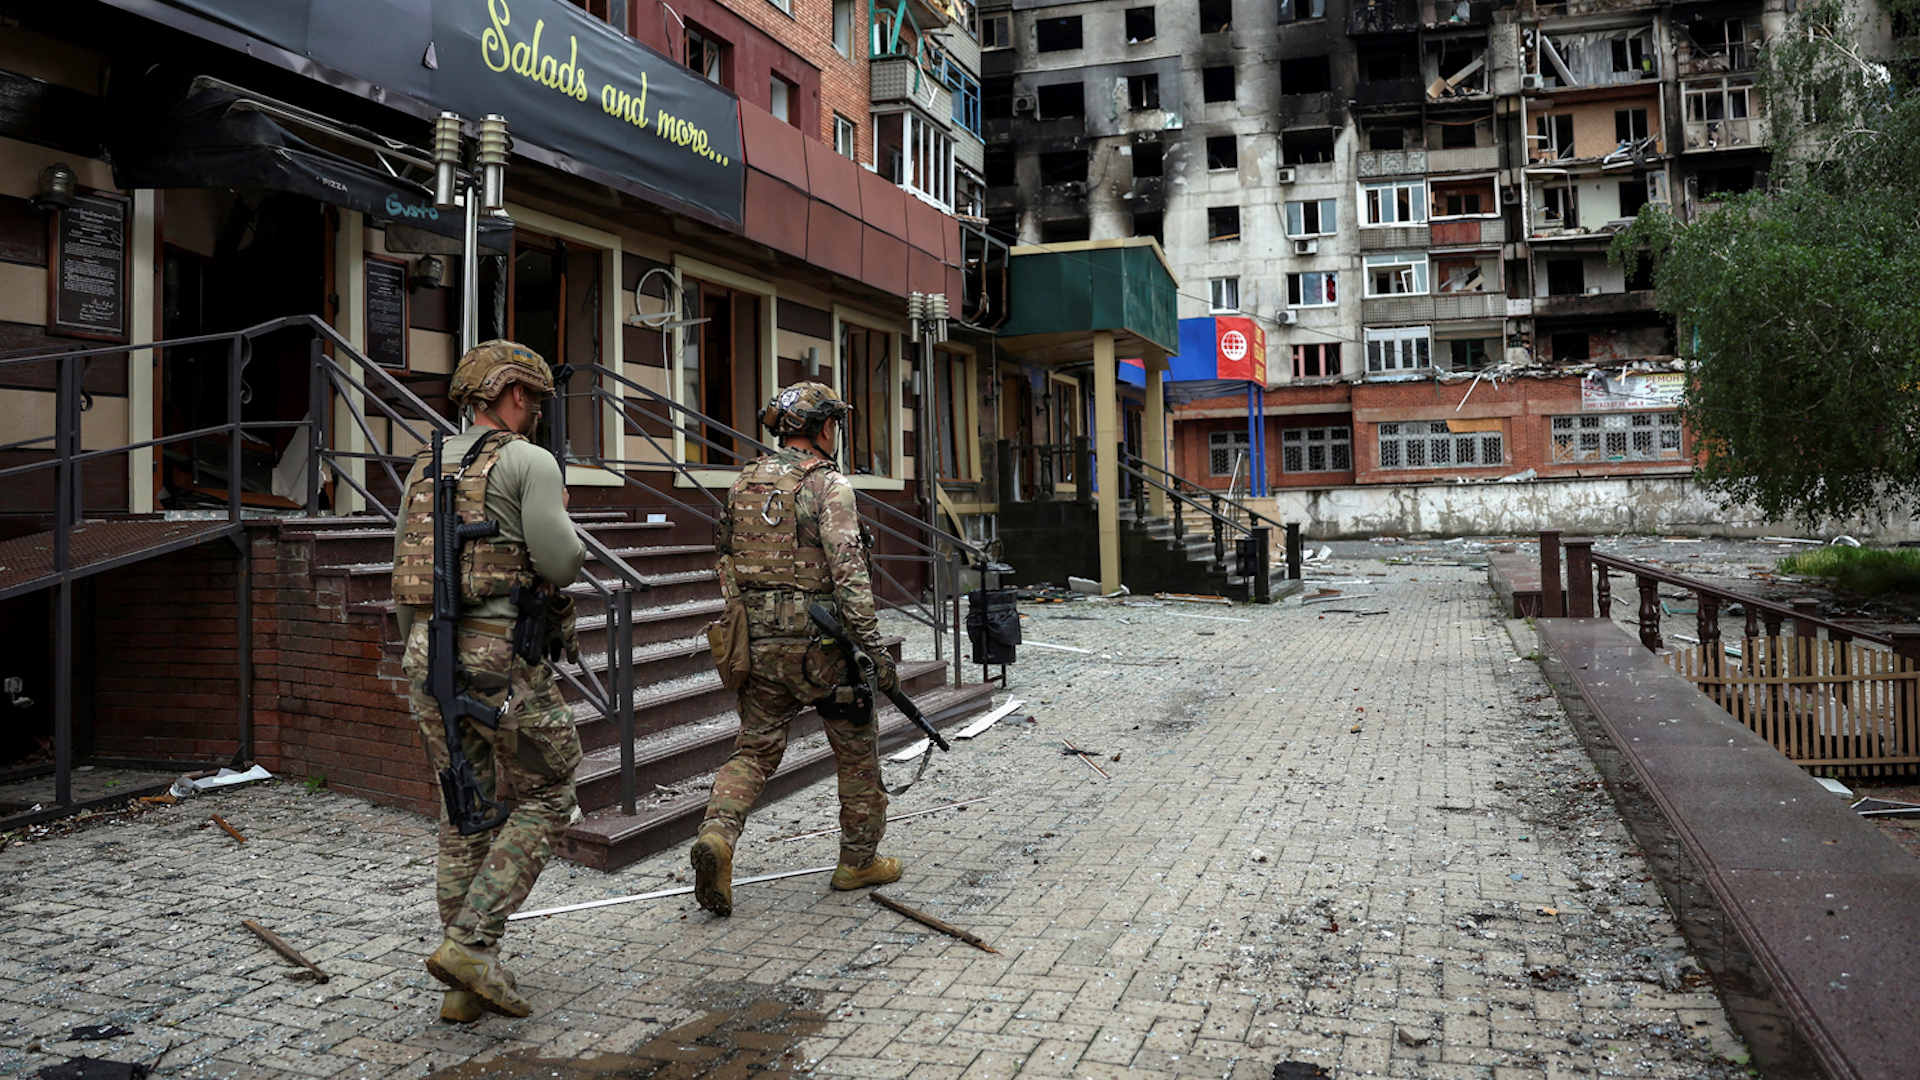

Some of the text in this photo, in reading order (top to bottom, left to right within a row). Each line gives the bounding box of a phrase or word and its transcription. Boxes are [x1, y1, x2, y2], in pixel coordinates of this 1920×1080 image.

[481, 0, 729, 167] Salads and more...
[321, 177, 349, 193] PIZZA
[385, 193, 439, 221] Gusto
